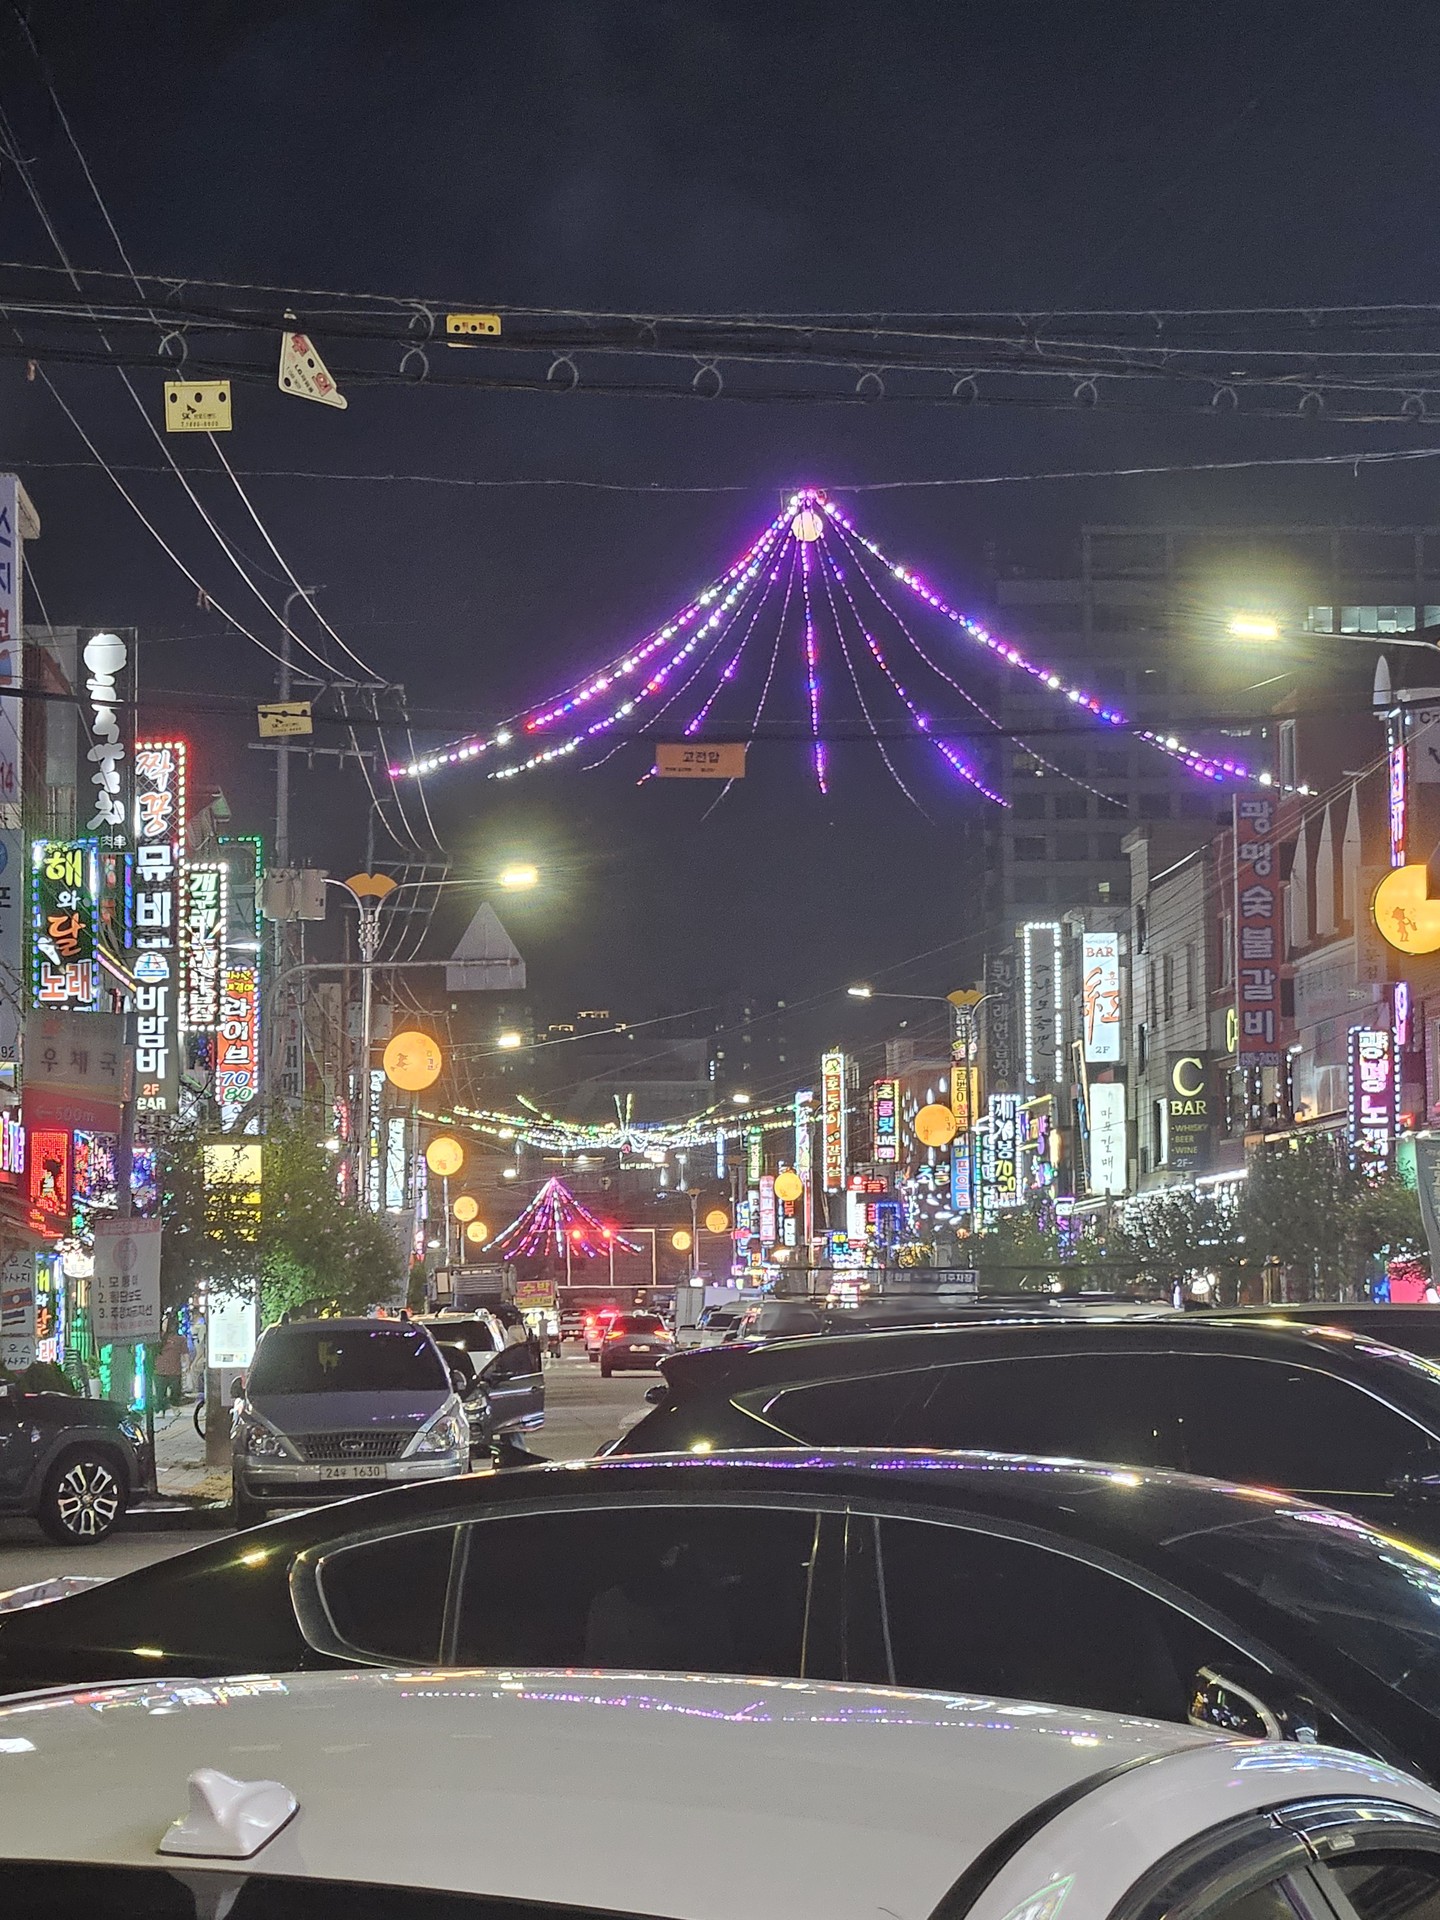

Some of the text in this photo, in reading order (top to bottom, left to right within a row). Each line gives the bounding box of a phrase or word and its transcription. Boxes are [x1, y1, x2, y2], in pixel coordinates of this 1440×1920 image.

[135, 751, 175, 836] 짝꿍
[1086, 947, 1115, 957] BAR
[136, 986, 169, 1079] 바밤바
[221, 997, 250, 1064] 라이브
[1095, 1046, 1110, 1054] 2F
[221, 1071, 249, 1086] 70
[1172, 1058, 1204, 1097] C
[143, 1084, 159, 1095] 2F
[224, 1087, 253, 1101] 80
[137, 1097, 166, 1110] BAR
[878, 1085, 894, 1133] 초콜릿
[1170, 1100, 1207, 1116] BAR
[877, 1136, 896, 1145] LIVE
[1175, 1135, 1195, 1143] BEER
[1175, 1146, 1198, 1154] WINE
[995, 1159, 1013, 1176] 70
[353, 1466, 380, 1477] 1630
